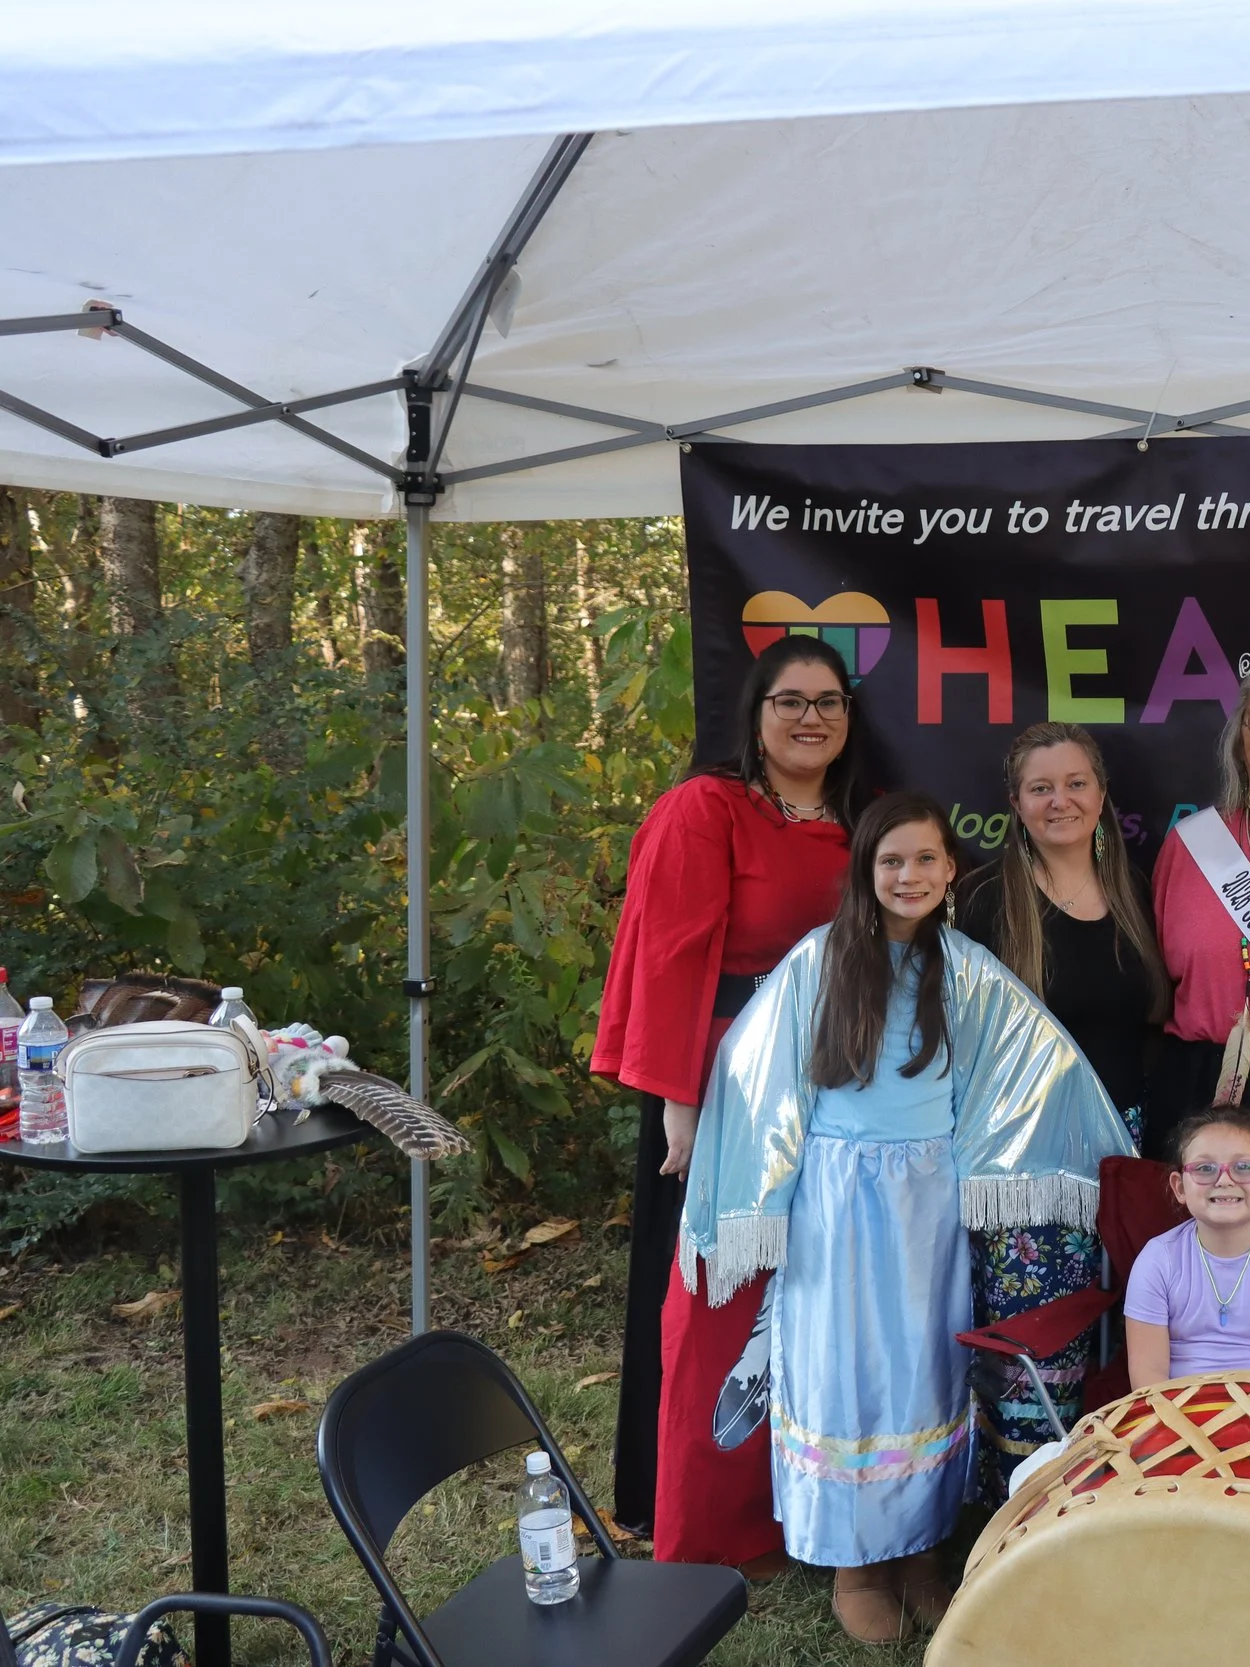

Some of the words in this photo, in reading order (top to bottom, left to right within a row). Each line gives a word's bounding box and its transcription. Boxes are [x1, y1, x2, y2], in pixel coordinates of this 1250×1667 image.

[730, 494, 790, 532] We
[802, 498, 905, 535] invite
[912, 507, 993, 545] you
[1006, 499, 1050, 534] to
[1063, 493, 1187, 534] travel
